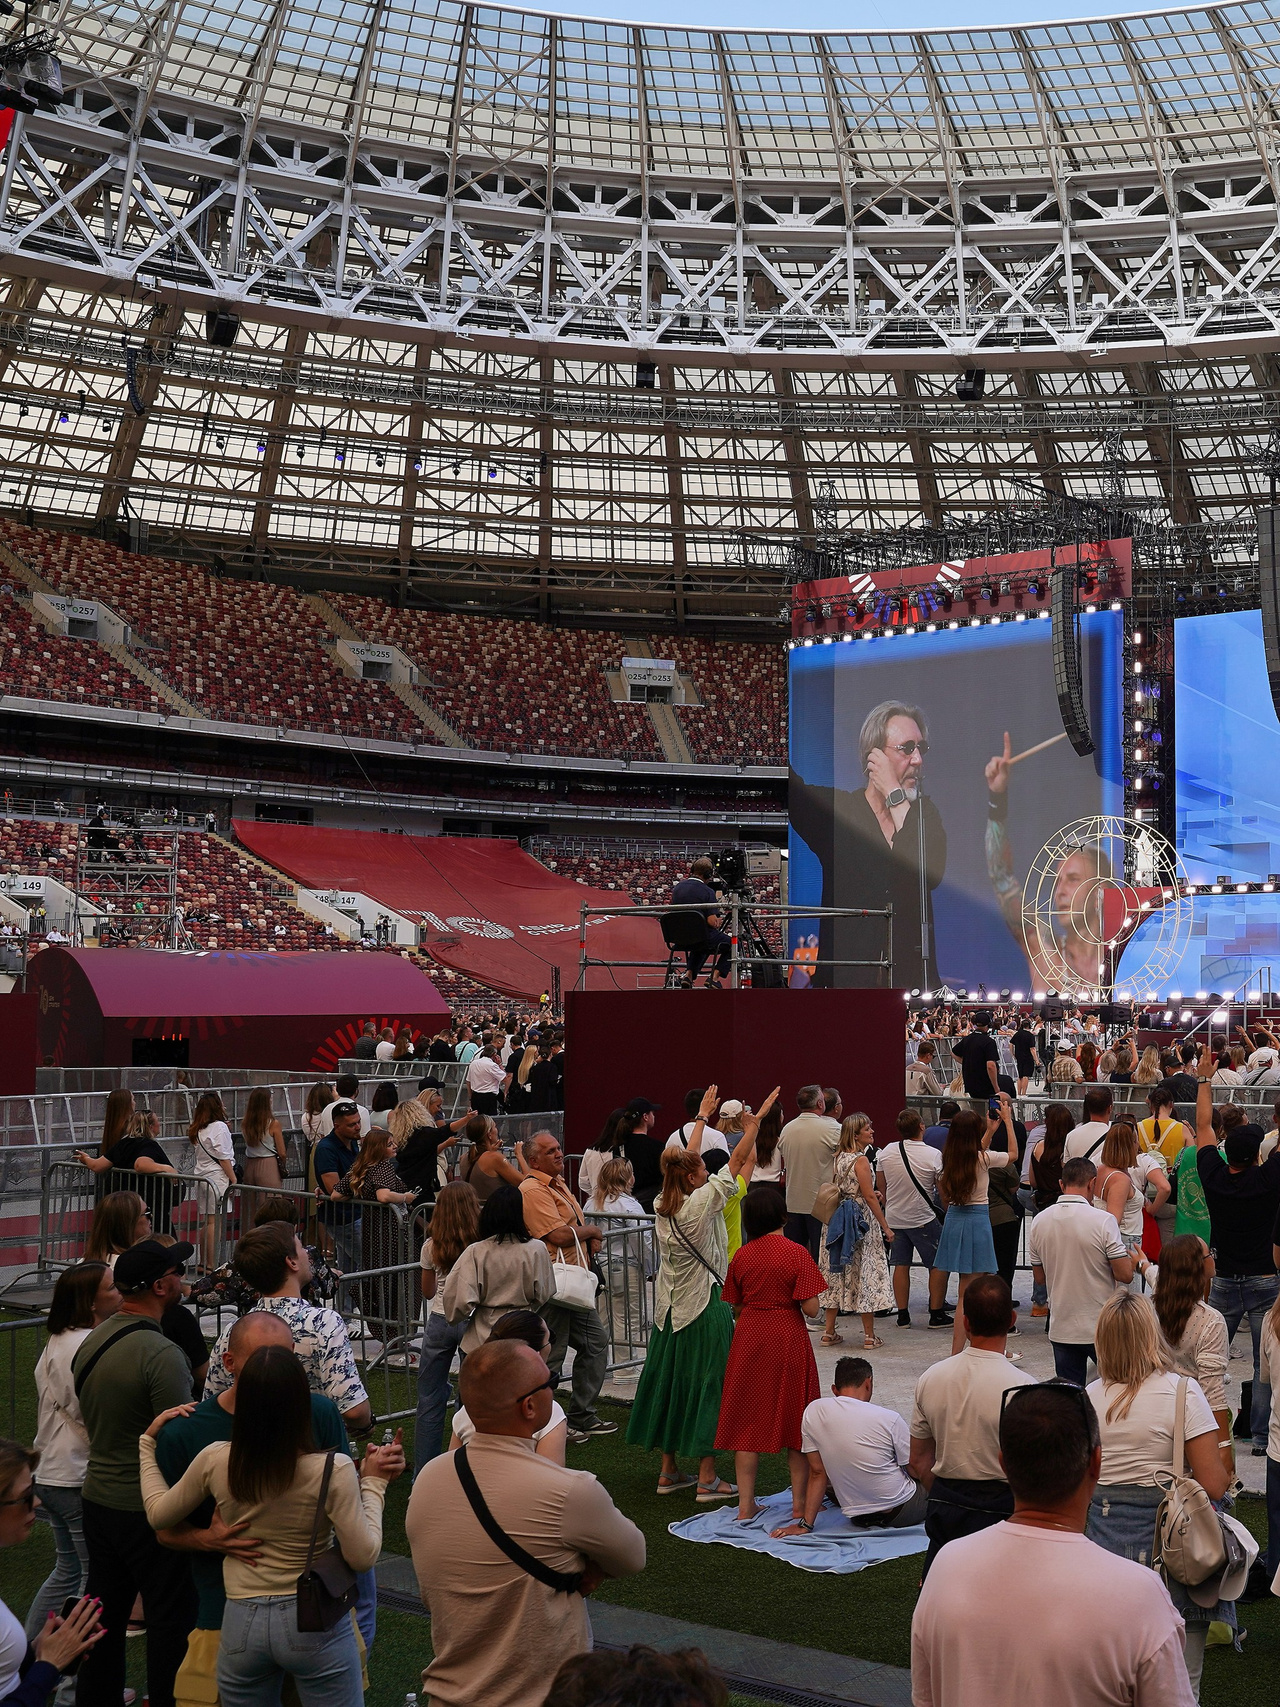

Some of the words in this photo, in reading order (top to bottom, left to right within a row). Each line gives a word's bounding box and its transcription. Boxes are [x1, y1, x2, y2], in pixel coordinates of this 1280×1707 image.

[78, 606, 96, 616] 257
[376, 651, 391, 659] 255
[22, 881, 42, 890] 149
[341, 896, 356, 904] 147
